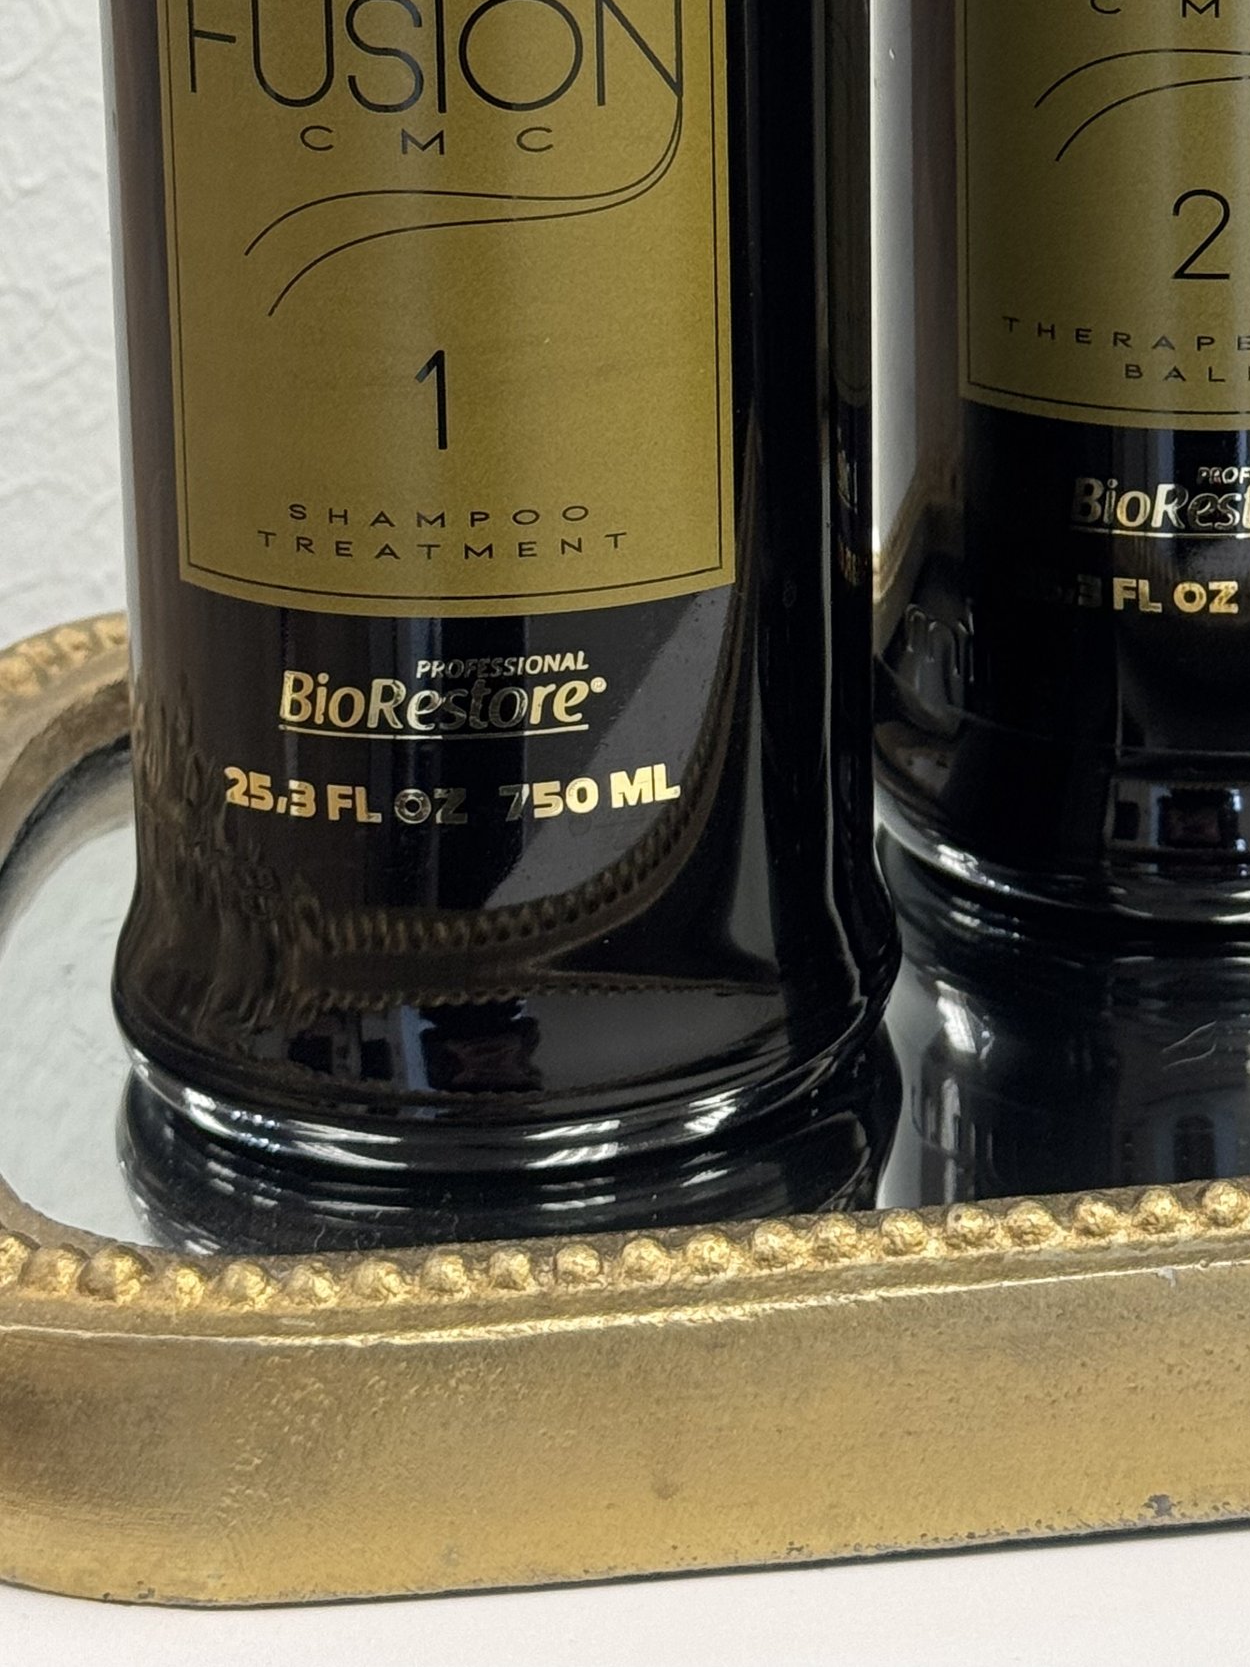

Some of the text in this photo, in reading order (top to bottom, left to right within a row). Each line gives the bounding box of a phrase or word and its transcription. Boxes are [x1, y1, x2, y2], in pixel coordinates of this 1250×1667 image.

[1172, 189, 1231, 281] 2
[414, 350, 448, 451] 1
[288, 502, 590, 529] SHAMPOO
[257, 530, 628, 561] TREATMENT
[1112, 576, 1163, 614] FL
[1173, 580, 1239, 614] OZ
[416, 651, 589, 679] PROFESSIONAL
[327, 783, 383, 824] FL
[394, 787, 468, 825] OZ
[499, 776, 599, 821] 750
[610, 762, 681, 808] ML
